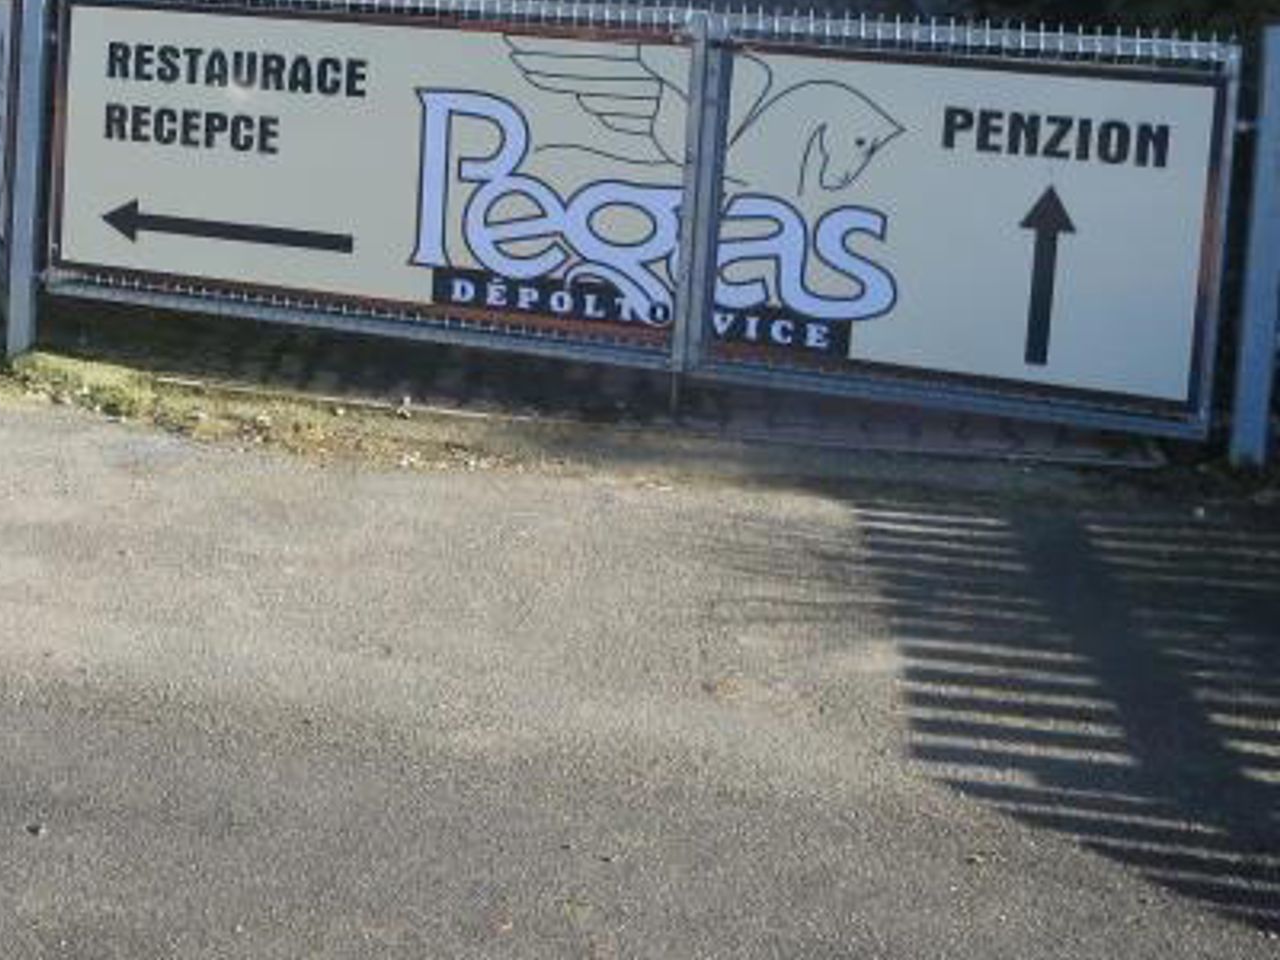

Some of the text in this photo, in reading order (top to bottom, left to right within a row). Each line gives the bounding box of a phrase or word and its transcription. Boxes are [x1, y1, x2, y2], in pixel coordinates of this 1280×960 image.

[105, 40, 368, 98] RESTAURACE
[103, 102, 280, 155] RECEPCE
[941, 105, 1171, 169] PENZION
[408, 87, 898, 327] Pegas
